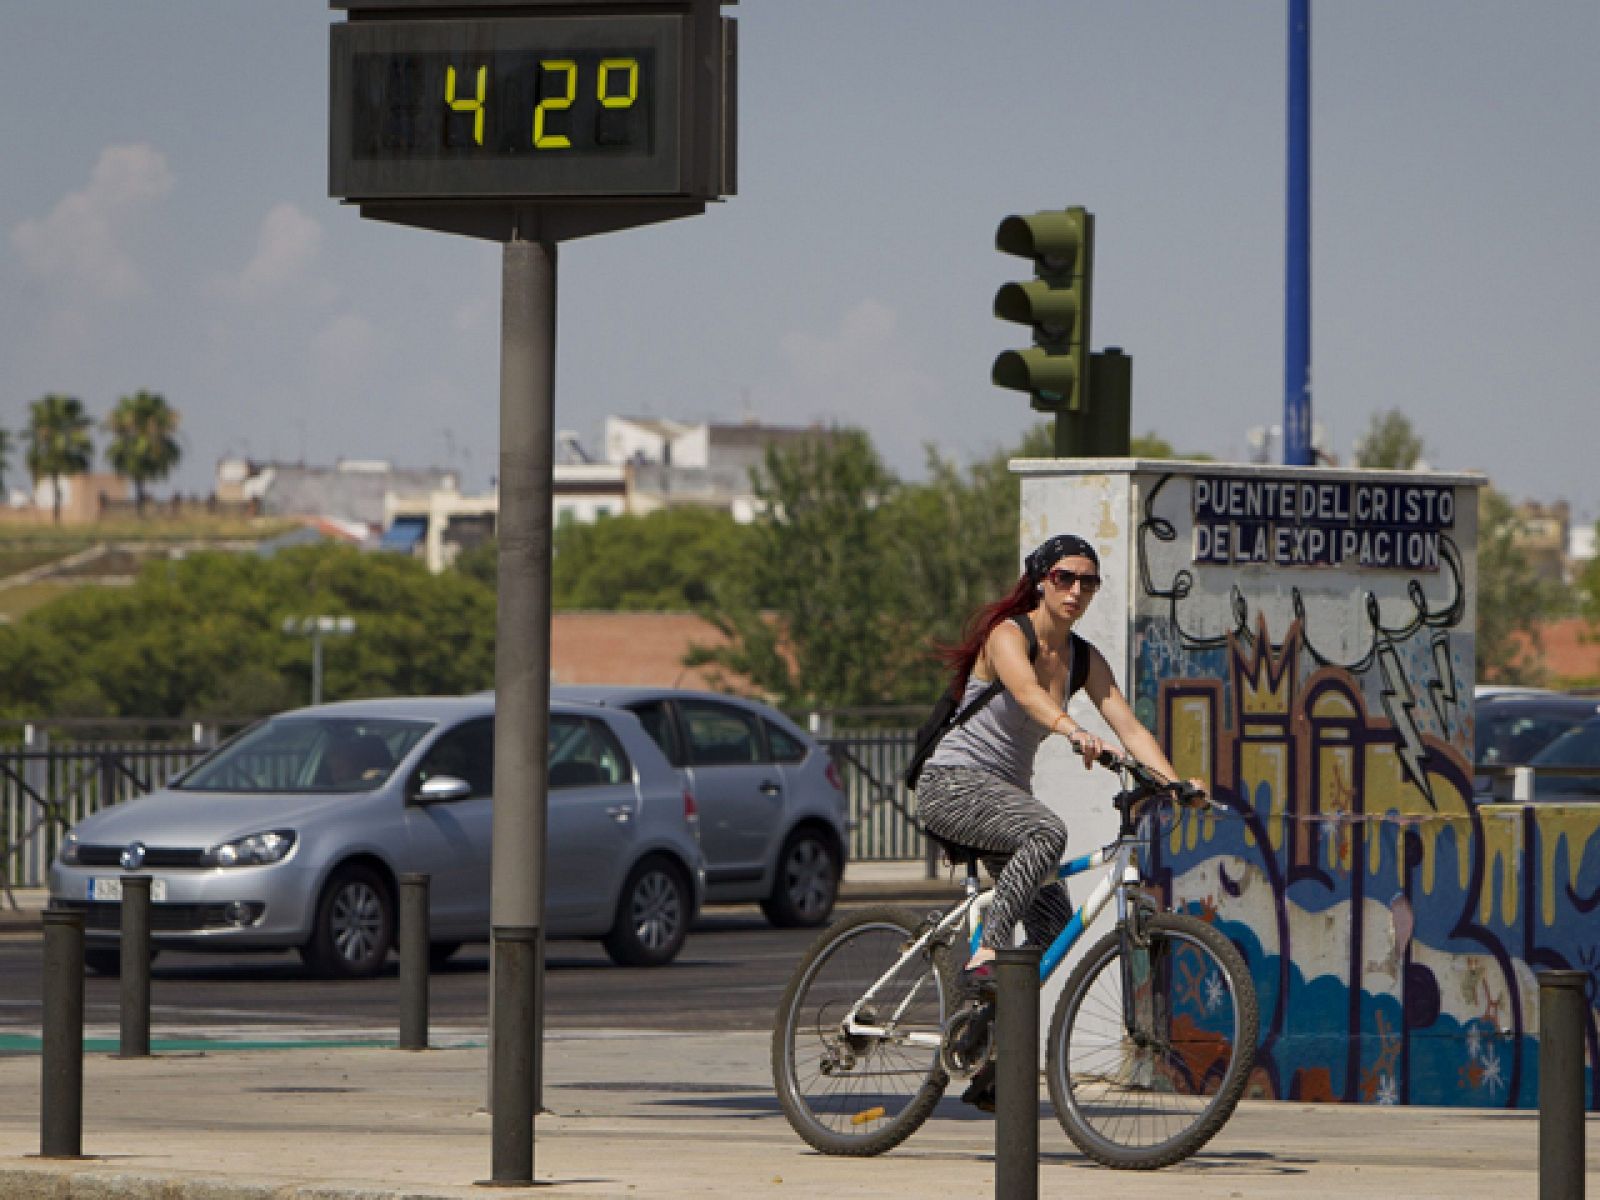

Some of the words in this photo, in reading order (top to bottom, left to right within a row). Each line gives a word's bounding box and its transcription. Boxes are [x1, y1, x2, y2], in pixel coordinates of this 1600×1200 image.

[1195, 480, 1296, 516] PUENTE
[1301, 485, 1348, 518] DEL
[1356, 487, 1453, 522] CRISTO
[1196, 524, 1229, 560] DE
[1235, 526, 1267, 561] LA
